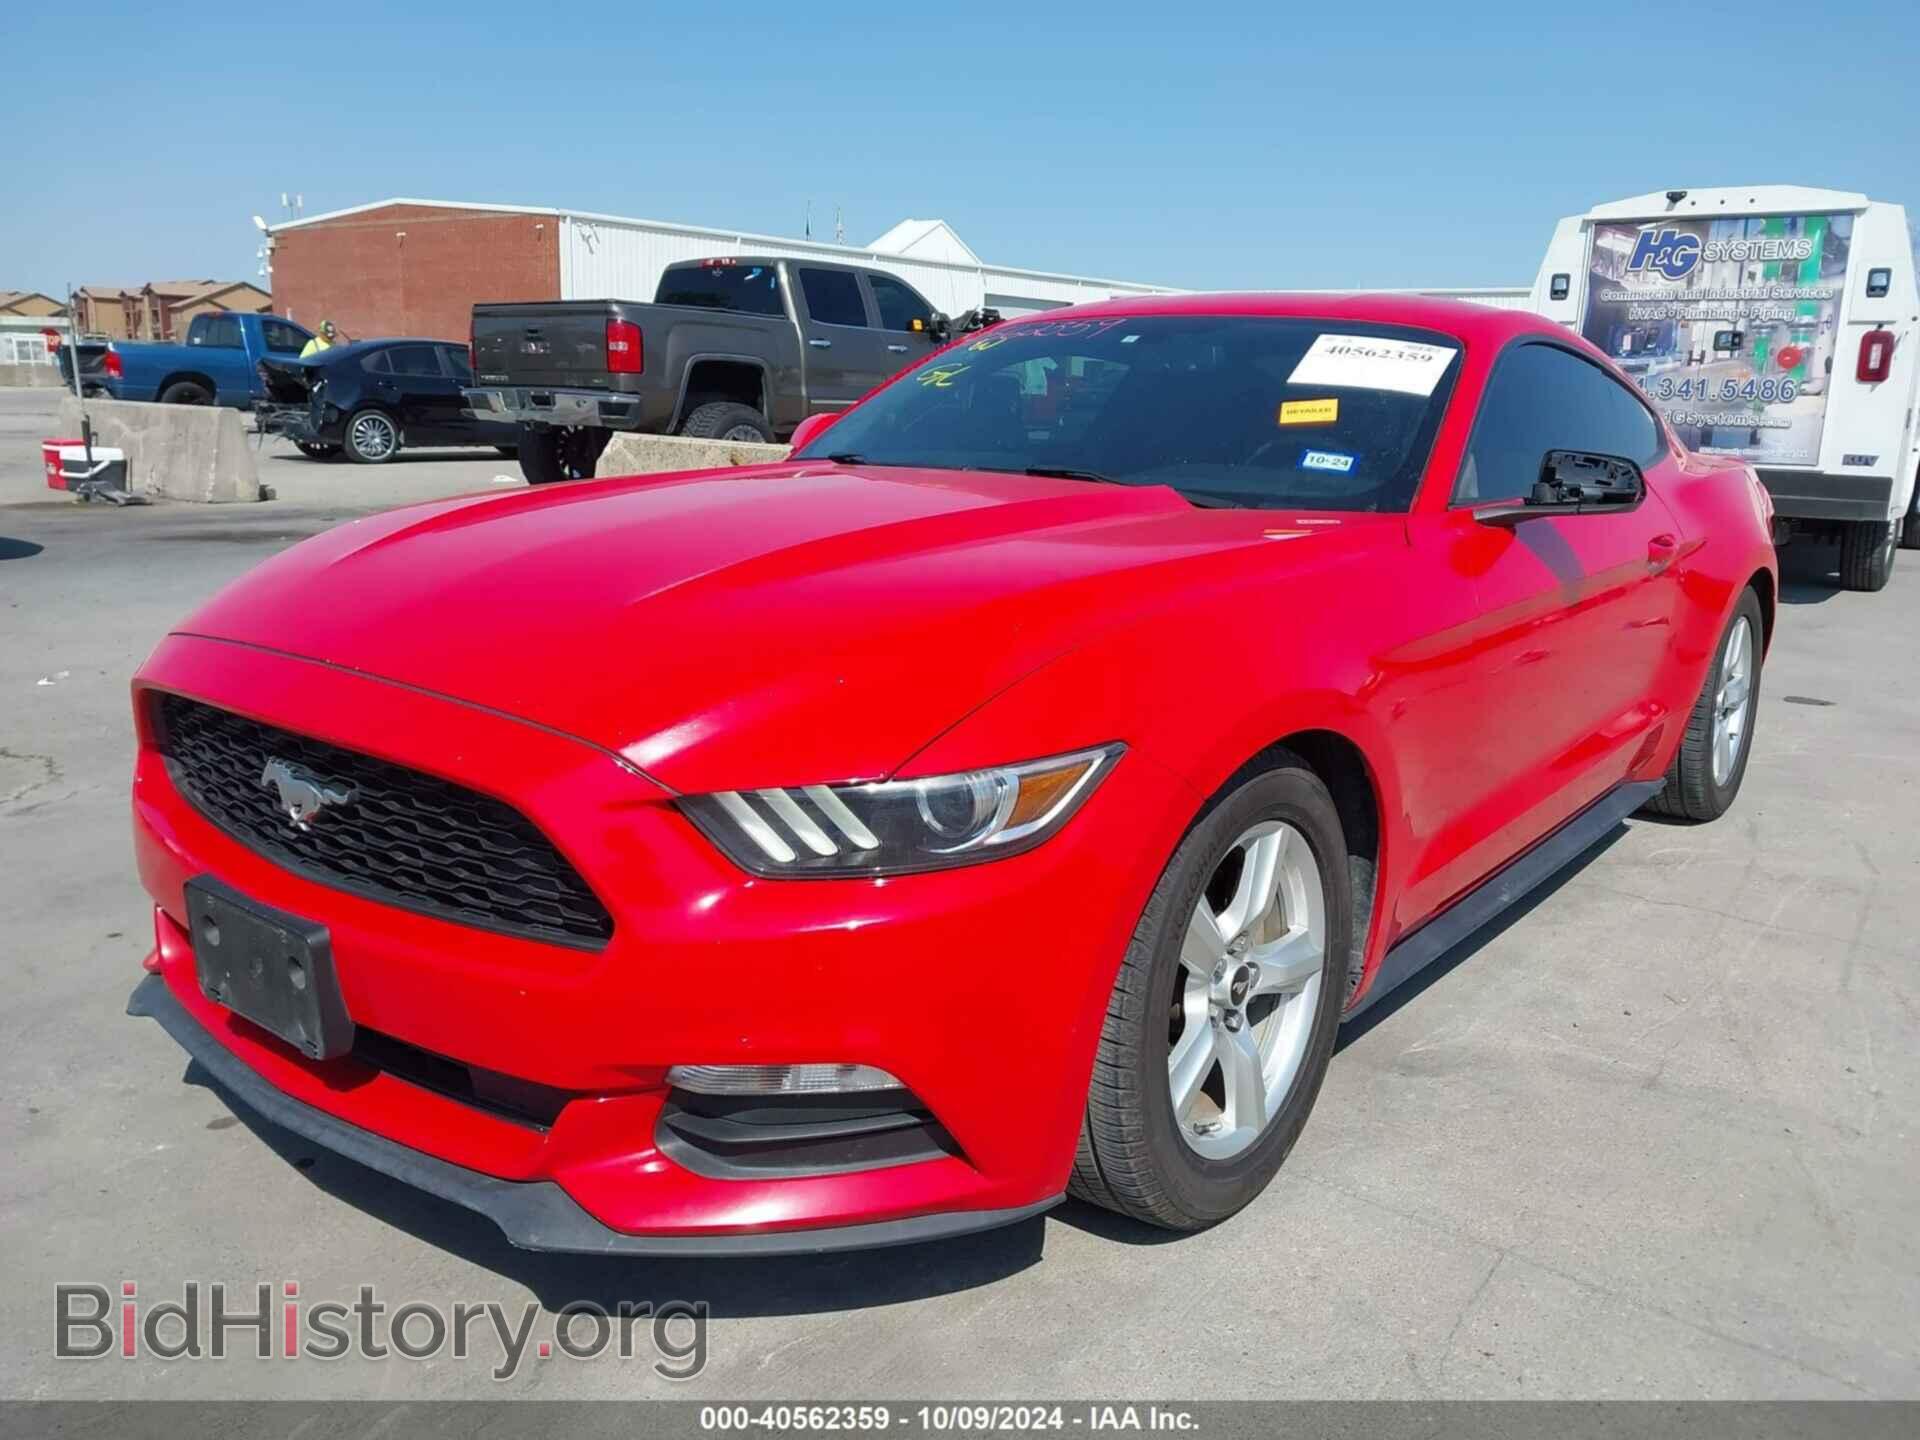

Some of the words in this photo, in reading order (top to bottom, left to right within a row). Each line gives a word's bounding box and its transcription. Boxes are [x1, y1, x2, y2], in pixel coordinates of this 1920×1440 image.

[1627, 229, 1703, 280] H&G
[1702, 239, 1813, 262] SYSTEMS
[1601, 288, 1675, 301] Commercial
[1677, 288, 1704, 300] and
[1705, 287, 1770, 300] Industrial
[1770, 286, 1834, 300] Services
[1629, 306, 1667, 320] HVAC
[1675, 305, 1741, 323] Plumbing
[1749, 305, 1797, 322] Piping
[1324, 344, 1434, 363] 40562359
[1307, 454, 1350, 467] 10-24
